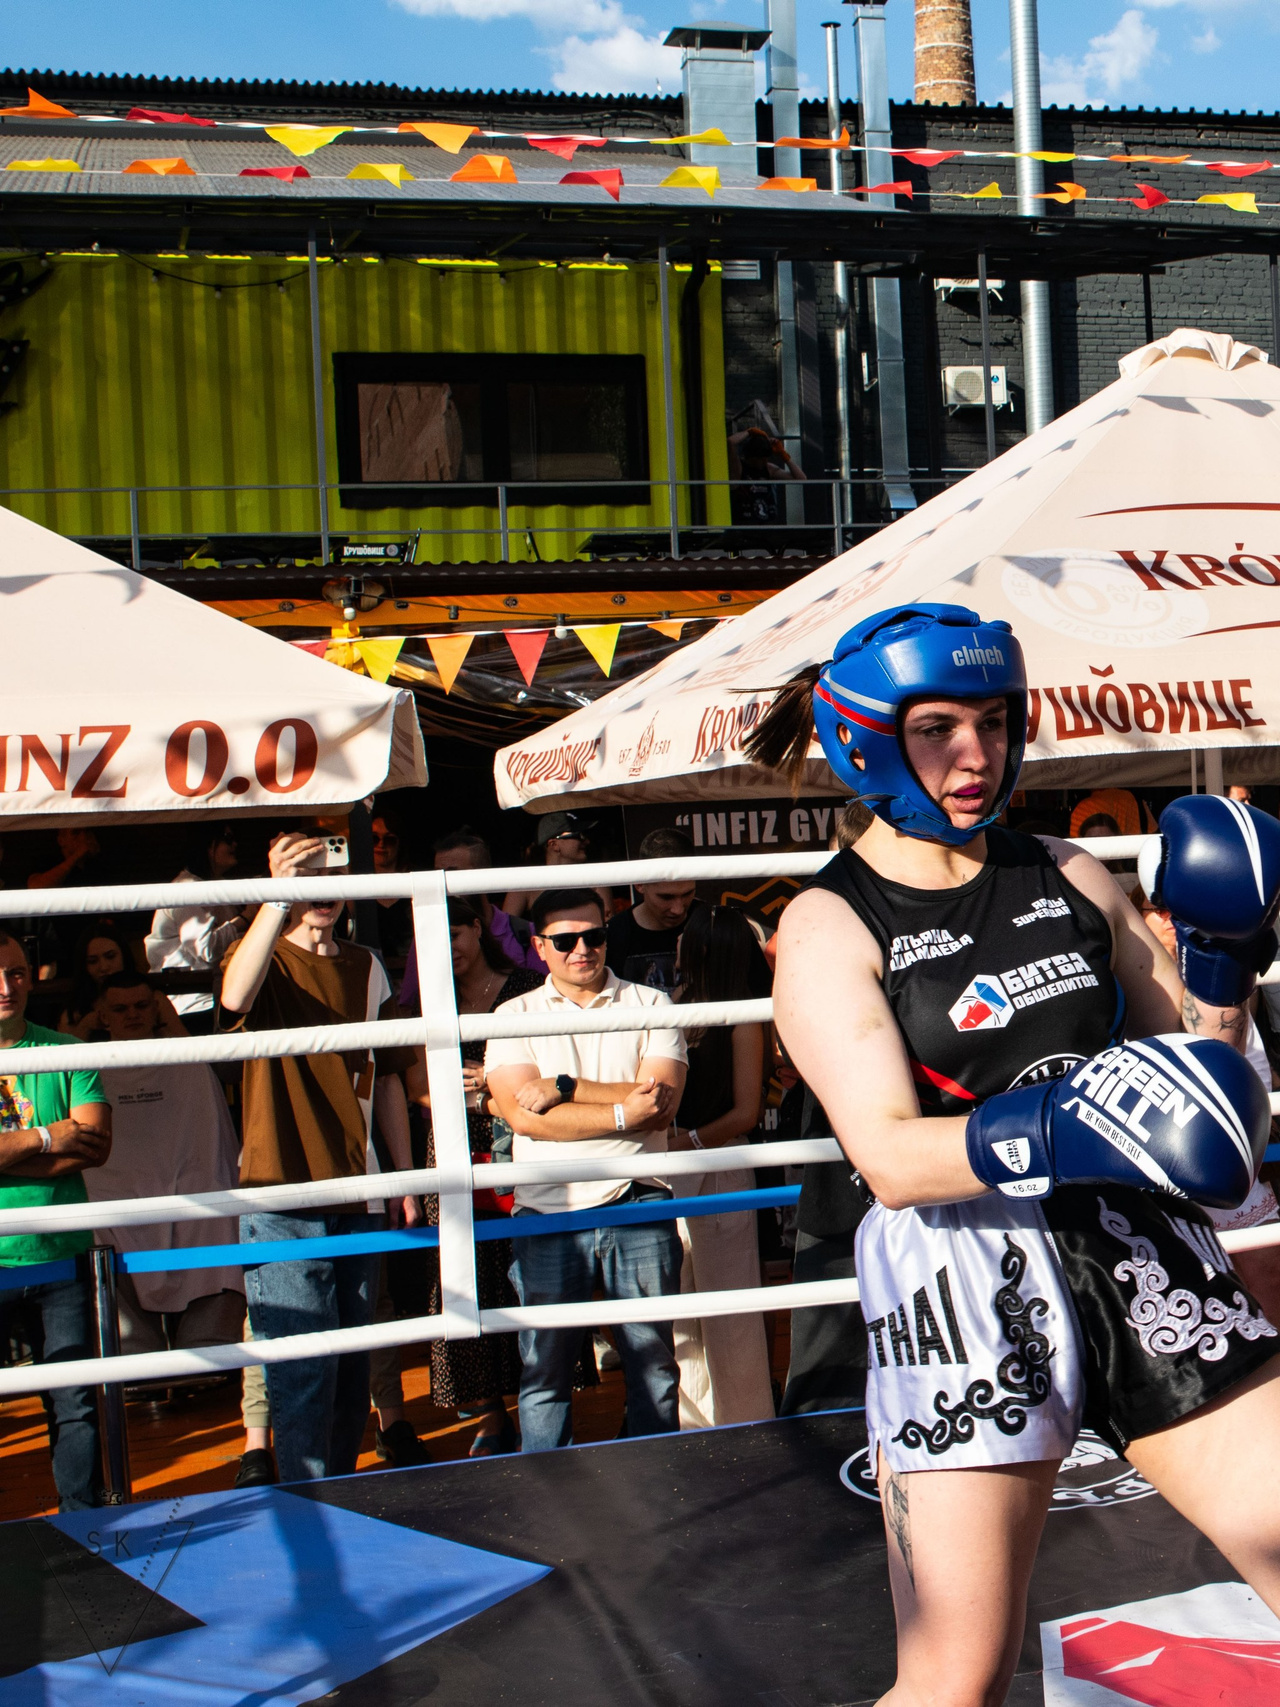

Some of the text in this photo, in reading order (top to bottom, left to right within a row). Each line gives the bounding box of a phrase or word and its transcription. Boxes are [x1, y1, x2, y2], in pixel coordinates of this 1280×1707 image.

[952, 645, 1005, 667] clinch
[164, 717, 318, 798] 0.0
[998, 951, 1093, 996] БИТВА
[1012, 973, 1100, 1010] ОБЩЕПИТОВ
[1070, 1060, 1152, 1144] HILL
[1093, 1046, 1201, 1130] GREEN
[1006, 1142, 1017, 1168] HILL
[1084, 1109, 1143, 1160] BE YOUR BEST SELF
